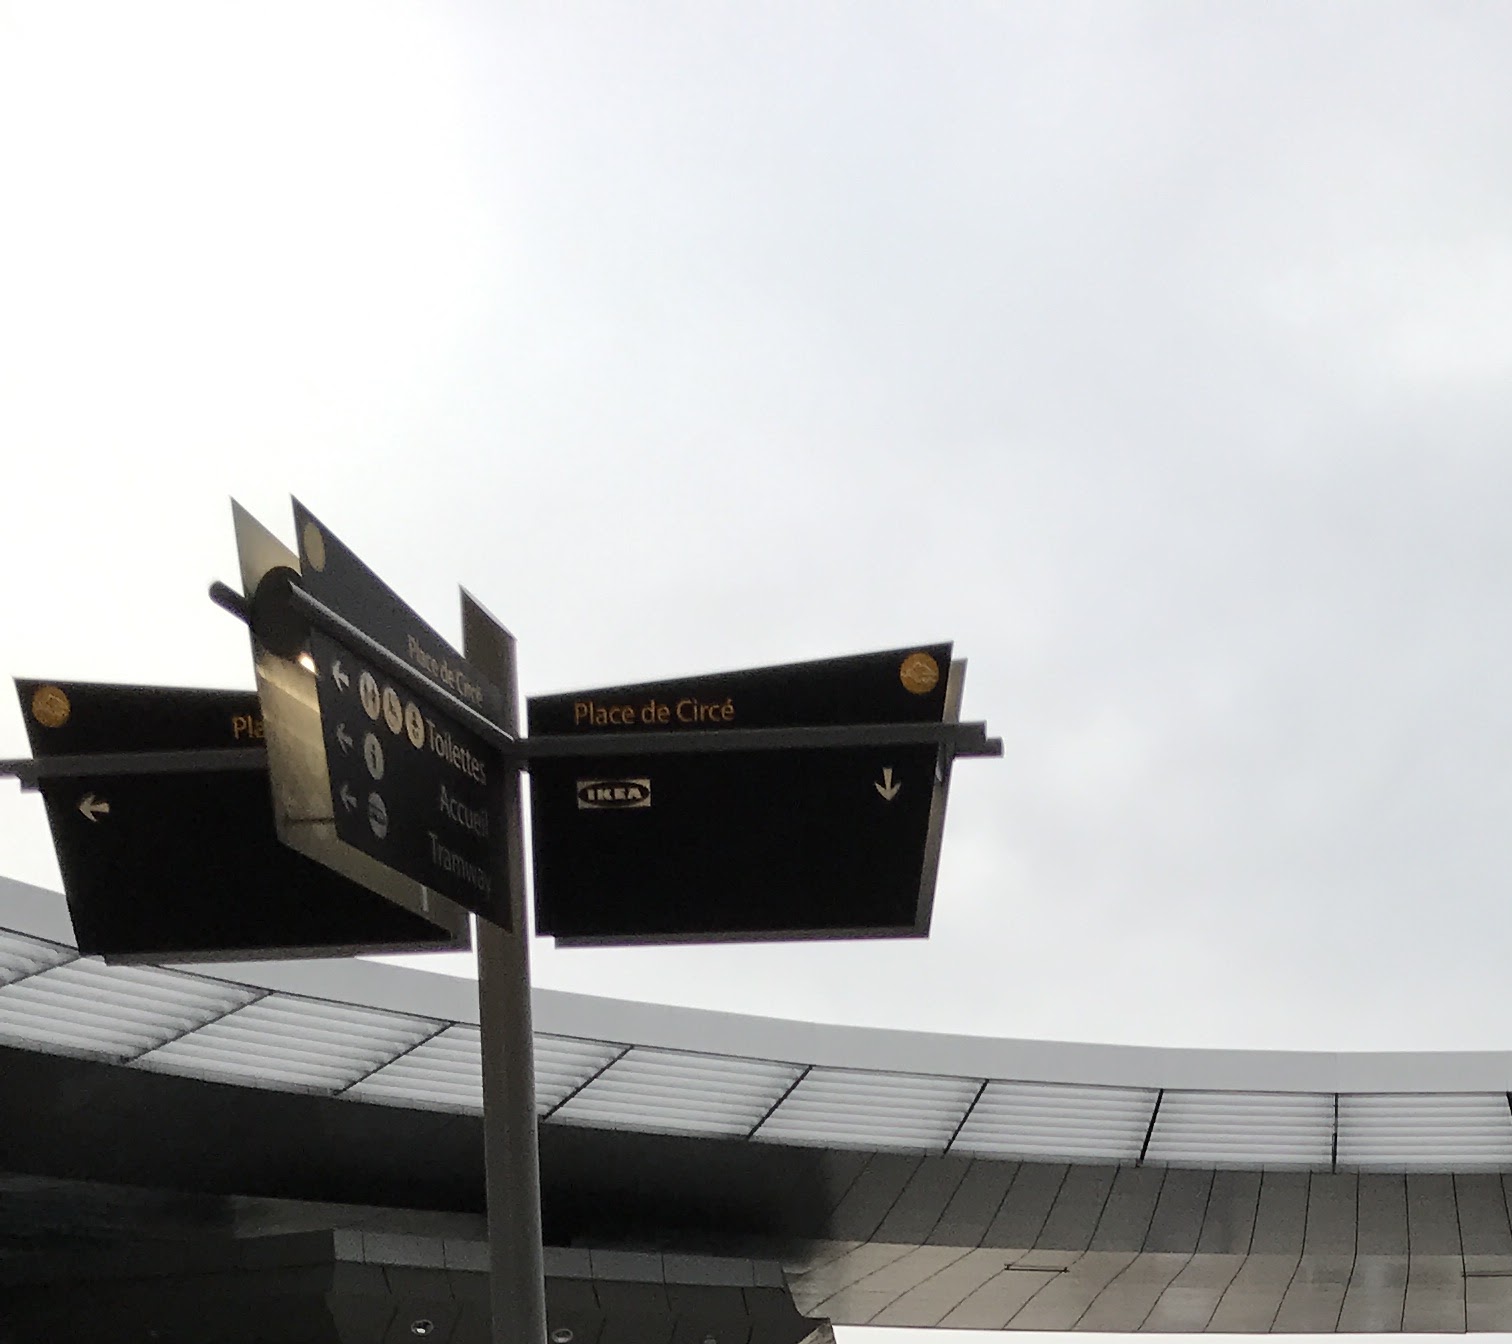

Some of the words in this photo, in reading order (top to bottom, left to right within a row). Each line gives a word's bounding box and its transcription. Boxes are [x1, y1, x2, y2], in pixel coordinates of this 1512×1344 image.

[574, 701, 635, 726] Place
[641, 699, 671, 724] de
[676, 697, 736, 722] Circé
[425, 716, 487, 786] Toilettes
[440, 783, 489, 838] Accueil
[587, 787, 642, 801] IKEA
[428, 830, 491, 898] Tramway
